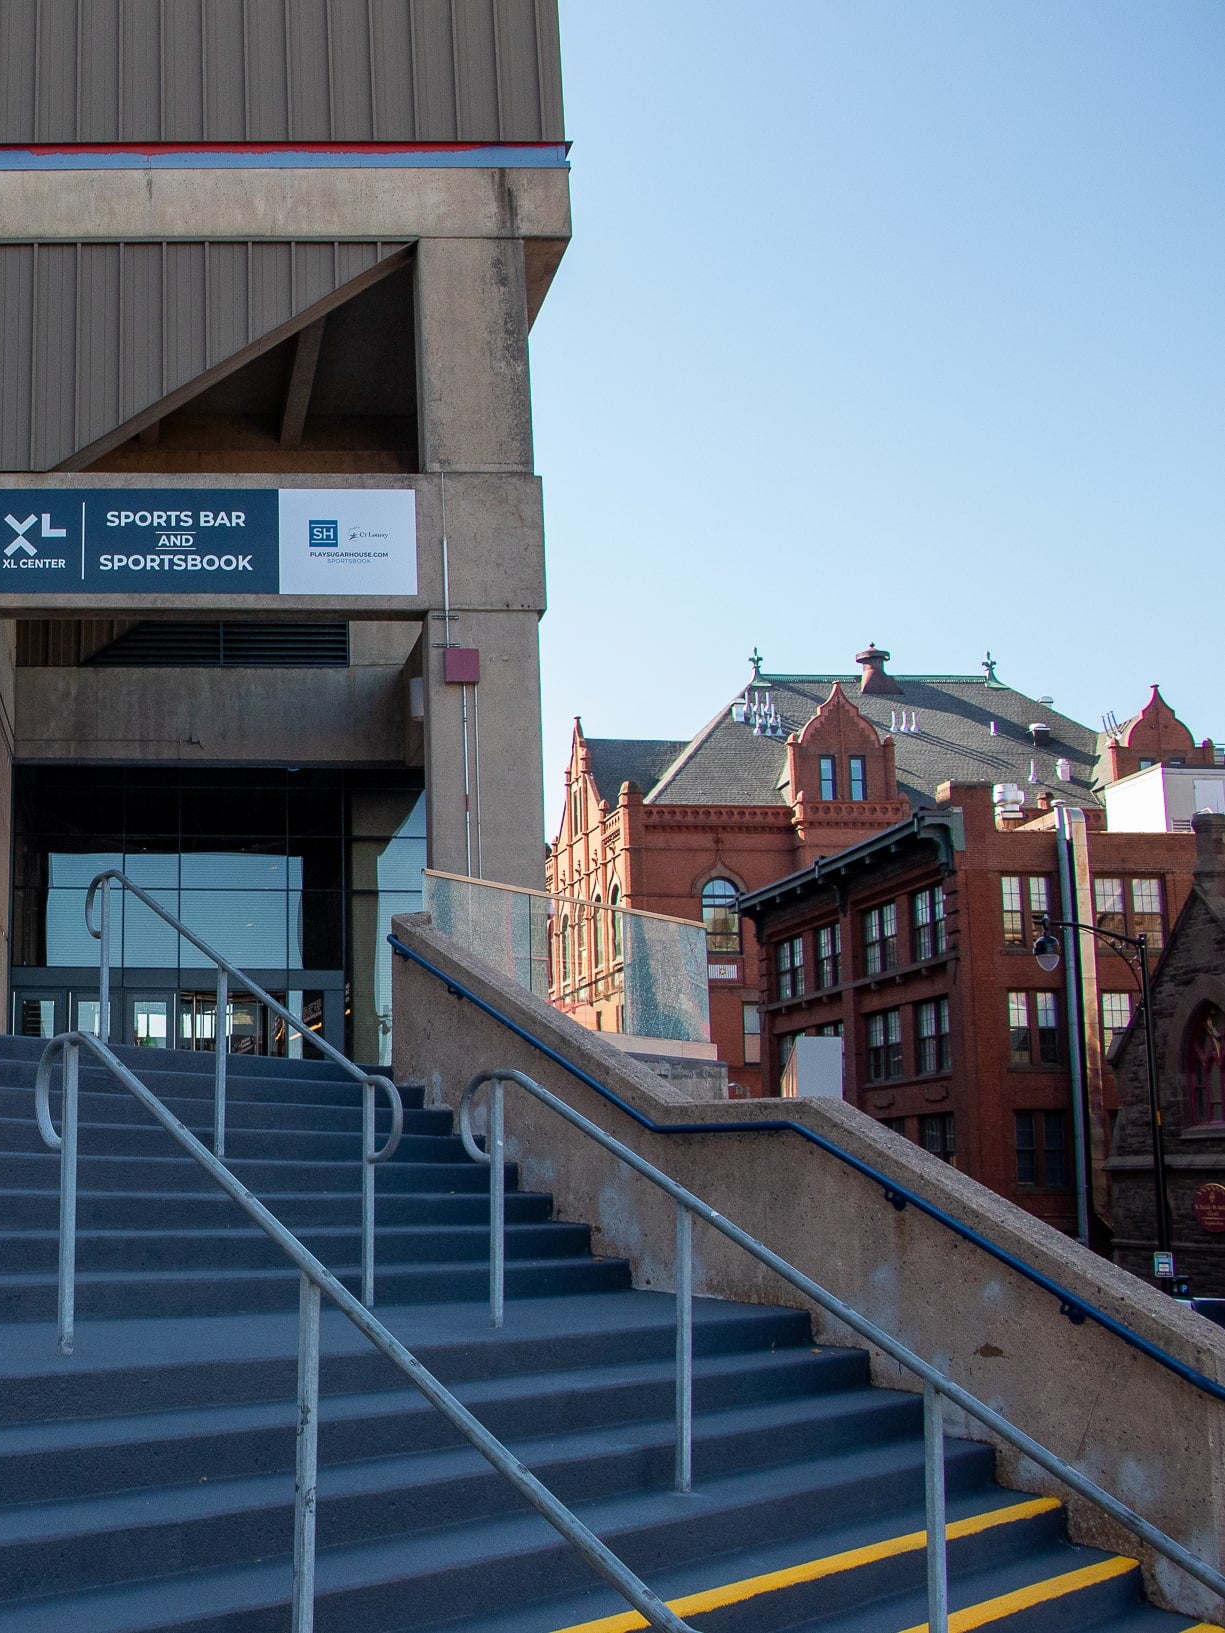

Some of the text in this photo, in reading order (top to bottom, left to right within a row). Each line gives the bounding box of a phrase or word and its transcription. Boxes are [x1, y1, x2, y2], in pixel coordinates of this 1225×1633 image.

[106, 511, 246, 527] SPORTS BAR
[4, 513, 66, 557] XL
[158, 535, 194, 547] AND
[313, 528, 334, 540] SH
[3, 559, 66, 569] XL CENTER
[99, 554, 253, 571] SPORTSBOOK
